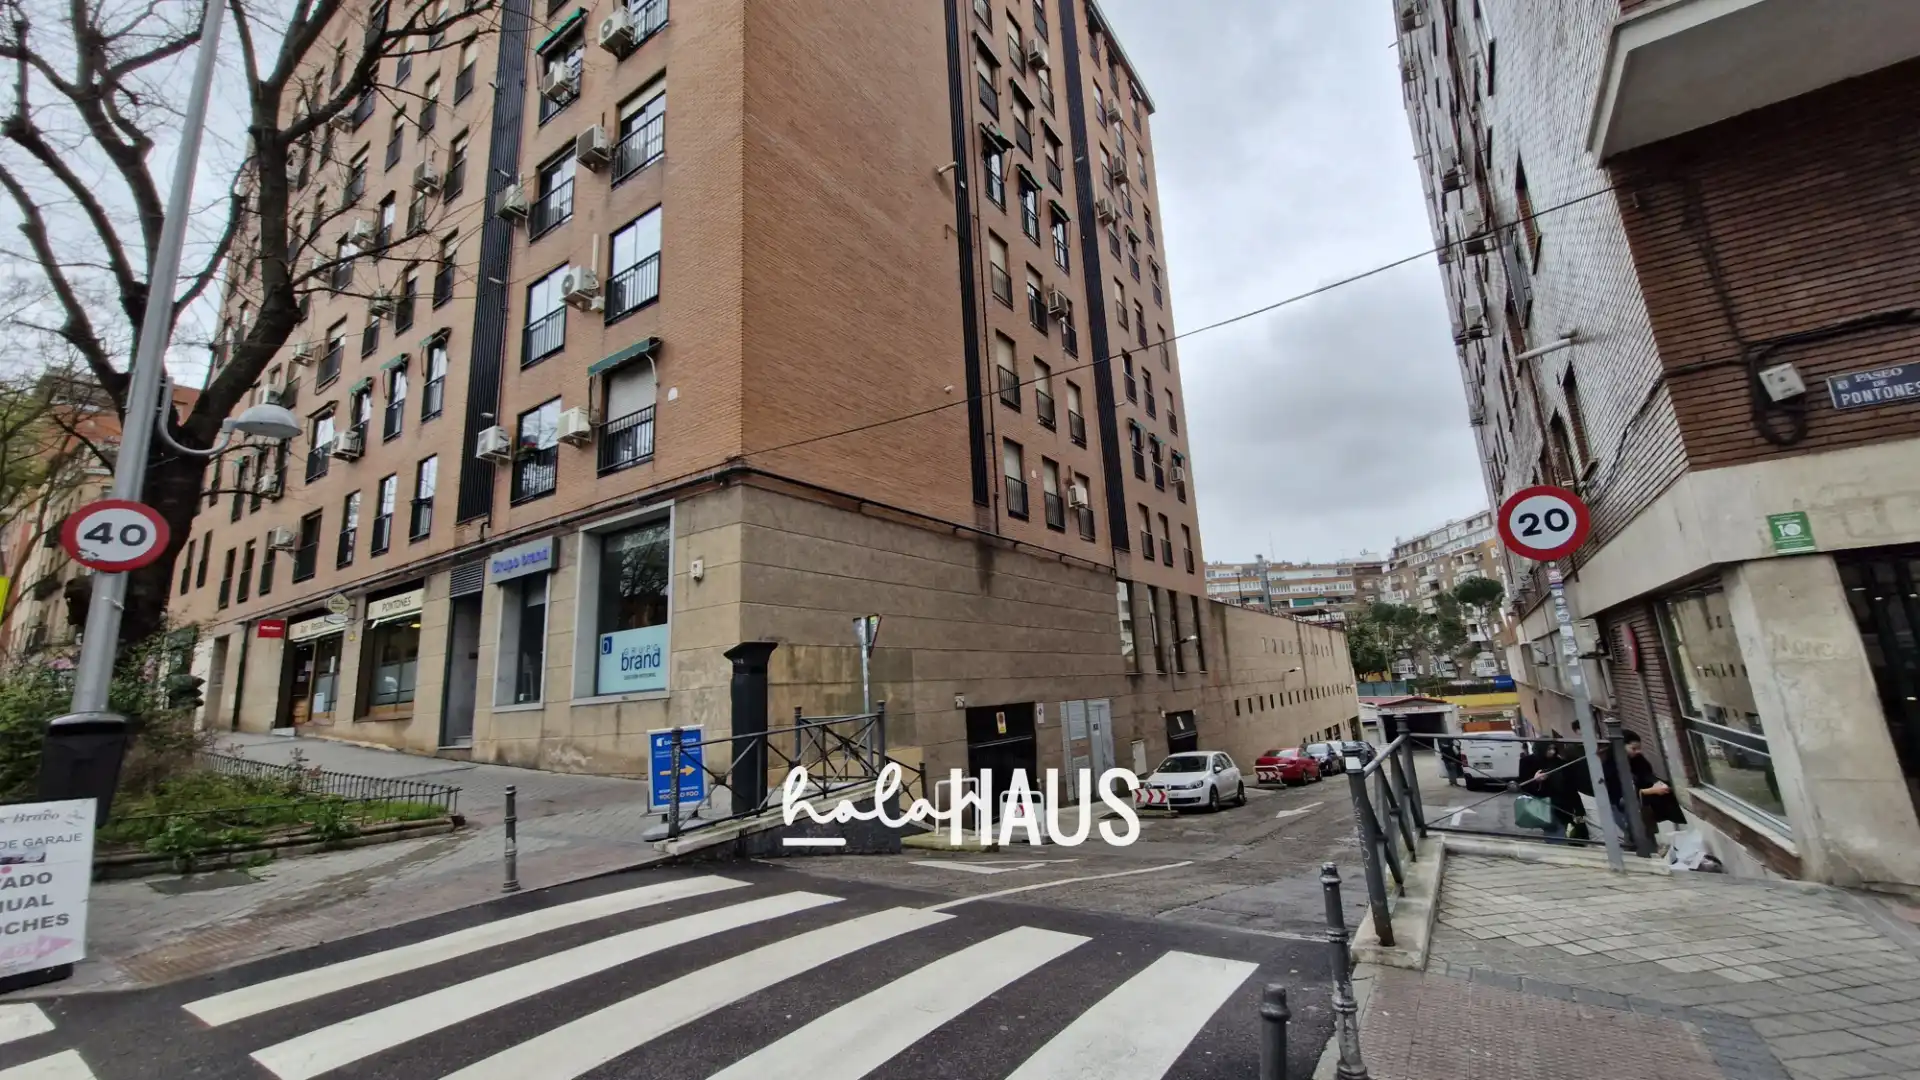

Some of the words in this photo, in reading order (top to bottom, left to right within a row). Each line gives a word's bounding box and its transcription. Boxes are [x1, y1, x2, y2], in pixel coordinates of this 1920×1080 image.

[1855, 367, 1903, 382] PASEO
[1872, 379, 1887, 388] DE
[1518, 508, 1570, 537] 20
[83, 522, 148, 547] 40
[492, 558, 520, 574] Grupo
[521, 549, 549, 568] brand
[381, 596, 411, 612] PONTONES
[624, 644, 660, 655] GRUPO
[621, 648, 660, 671] brand
[23, 832, 83, 848] GARAJE
[0, 872, 53, 891] ADO
[0, 894, 54, 914] UAL
